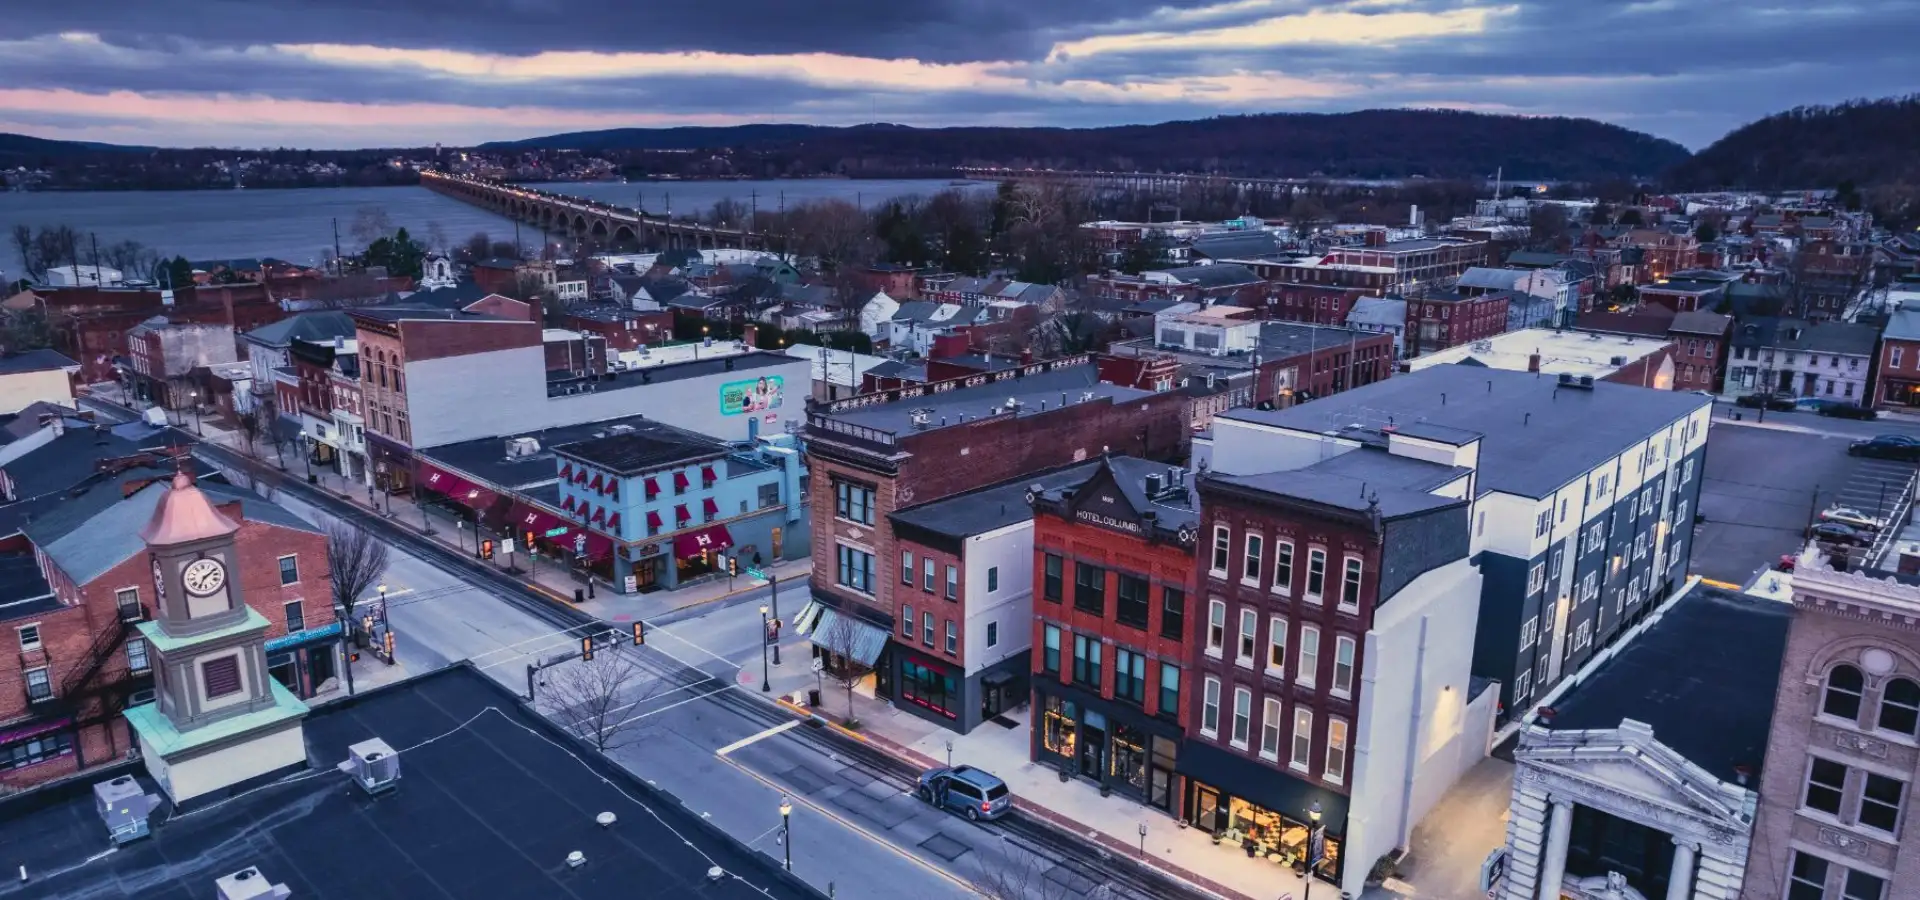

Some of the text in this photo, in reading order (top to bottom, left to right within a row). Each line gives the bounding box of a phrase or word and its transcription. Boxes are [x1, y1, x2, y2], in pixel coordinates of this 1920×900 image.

[429, 473, 441, 483] H
[525, 513, 537, 524] H
[1076, 510, 1103, 523] HOTEL
